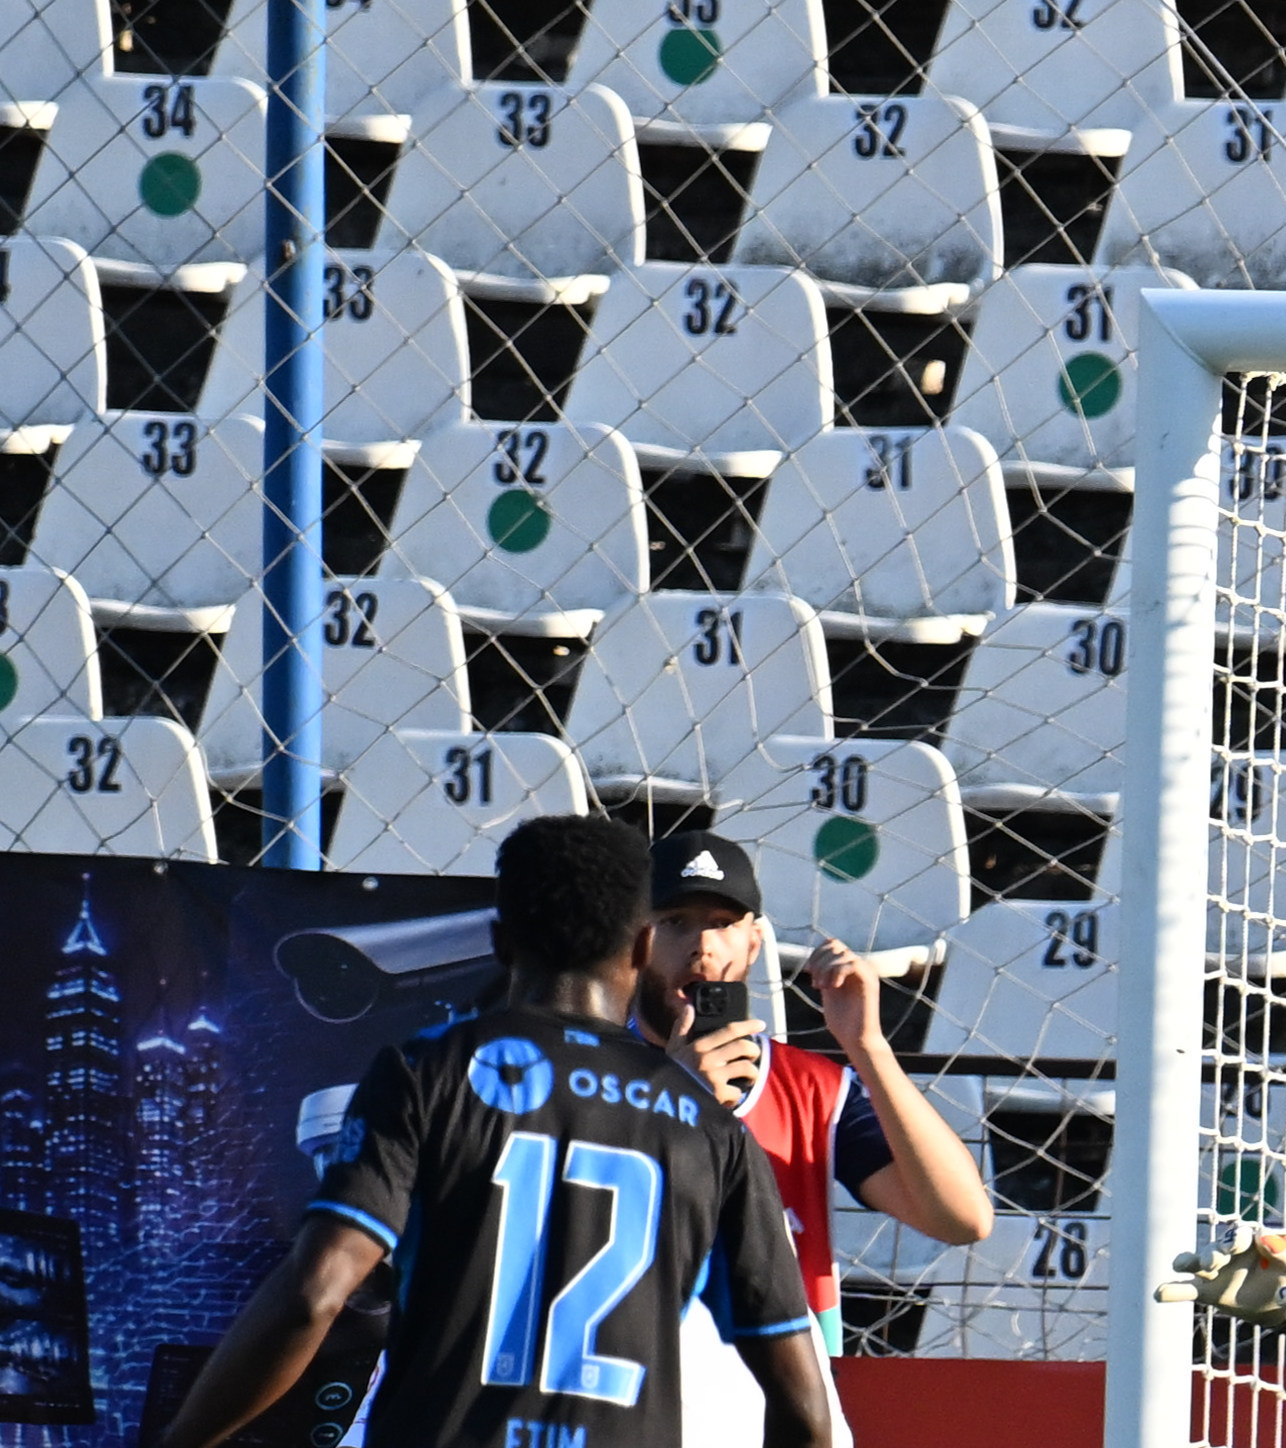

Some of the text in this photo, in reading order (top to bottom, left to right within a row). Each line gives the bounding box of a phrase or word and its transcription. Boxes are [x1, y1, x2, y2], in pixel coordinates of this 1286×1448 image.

[143, 85, 194, 137] 34
[498, 93, 551, 148] 33
[855, 105, 907, 159] 32
[1225, 109, 1273, 163] 31
[323, 266, 375, 321] 33
[684, 281, 735, 335] 32
[1066, 284, 1113, 342] 31
[142, 421, 196, 476] 33
[494, 431, 549, 484] 32
[865, 435, 912, 490] 31
[1229, 444, 1284, 500] 30
[324, 590, 376, 648] 32
[694, 608, 743, 666] 31
[1070, 618, 1123, 675] 30
[66, 736, 121, 793] 32
[443, 746, 495, 805] 31
[810, 754, 868, 812] 30
[1044, 912, 1097, 968] 29
[569, 1068, 699, 1127] OSCAR
[481, 1131, 664, 1408] 12
[1033, 1221, 1088, 1279] 28
